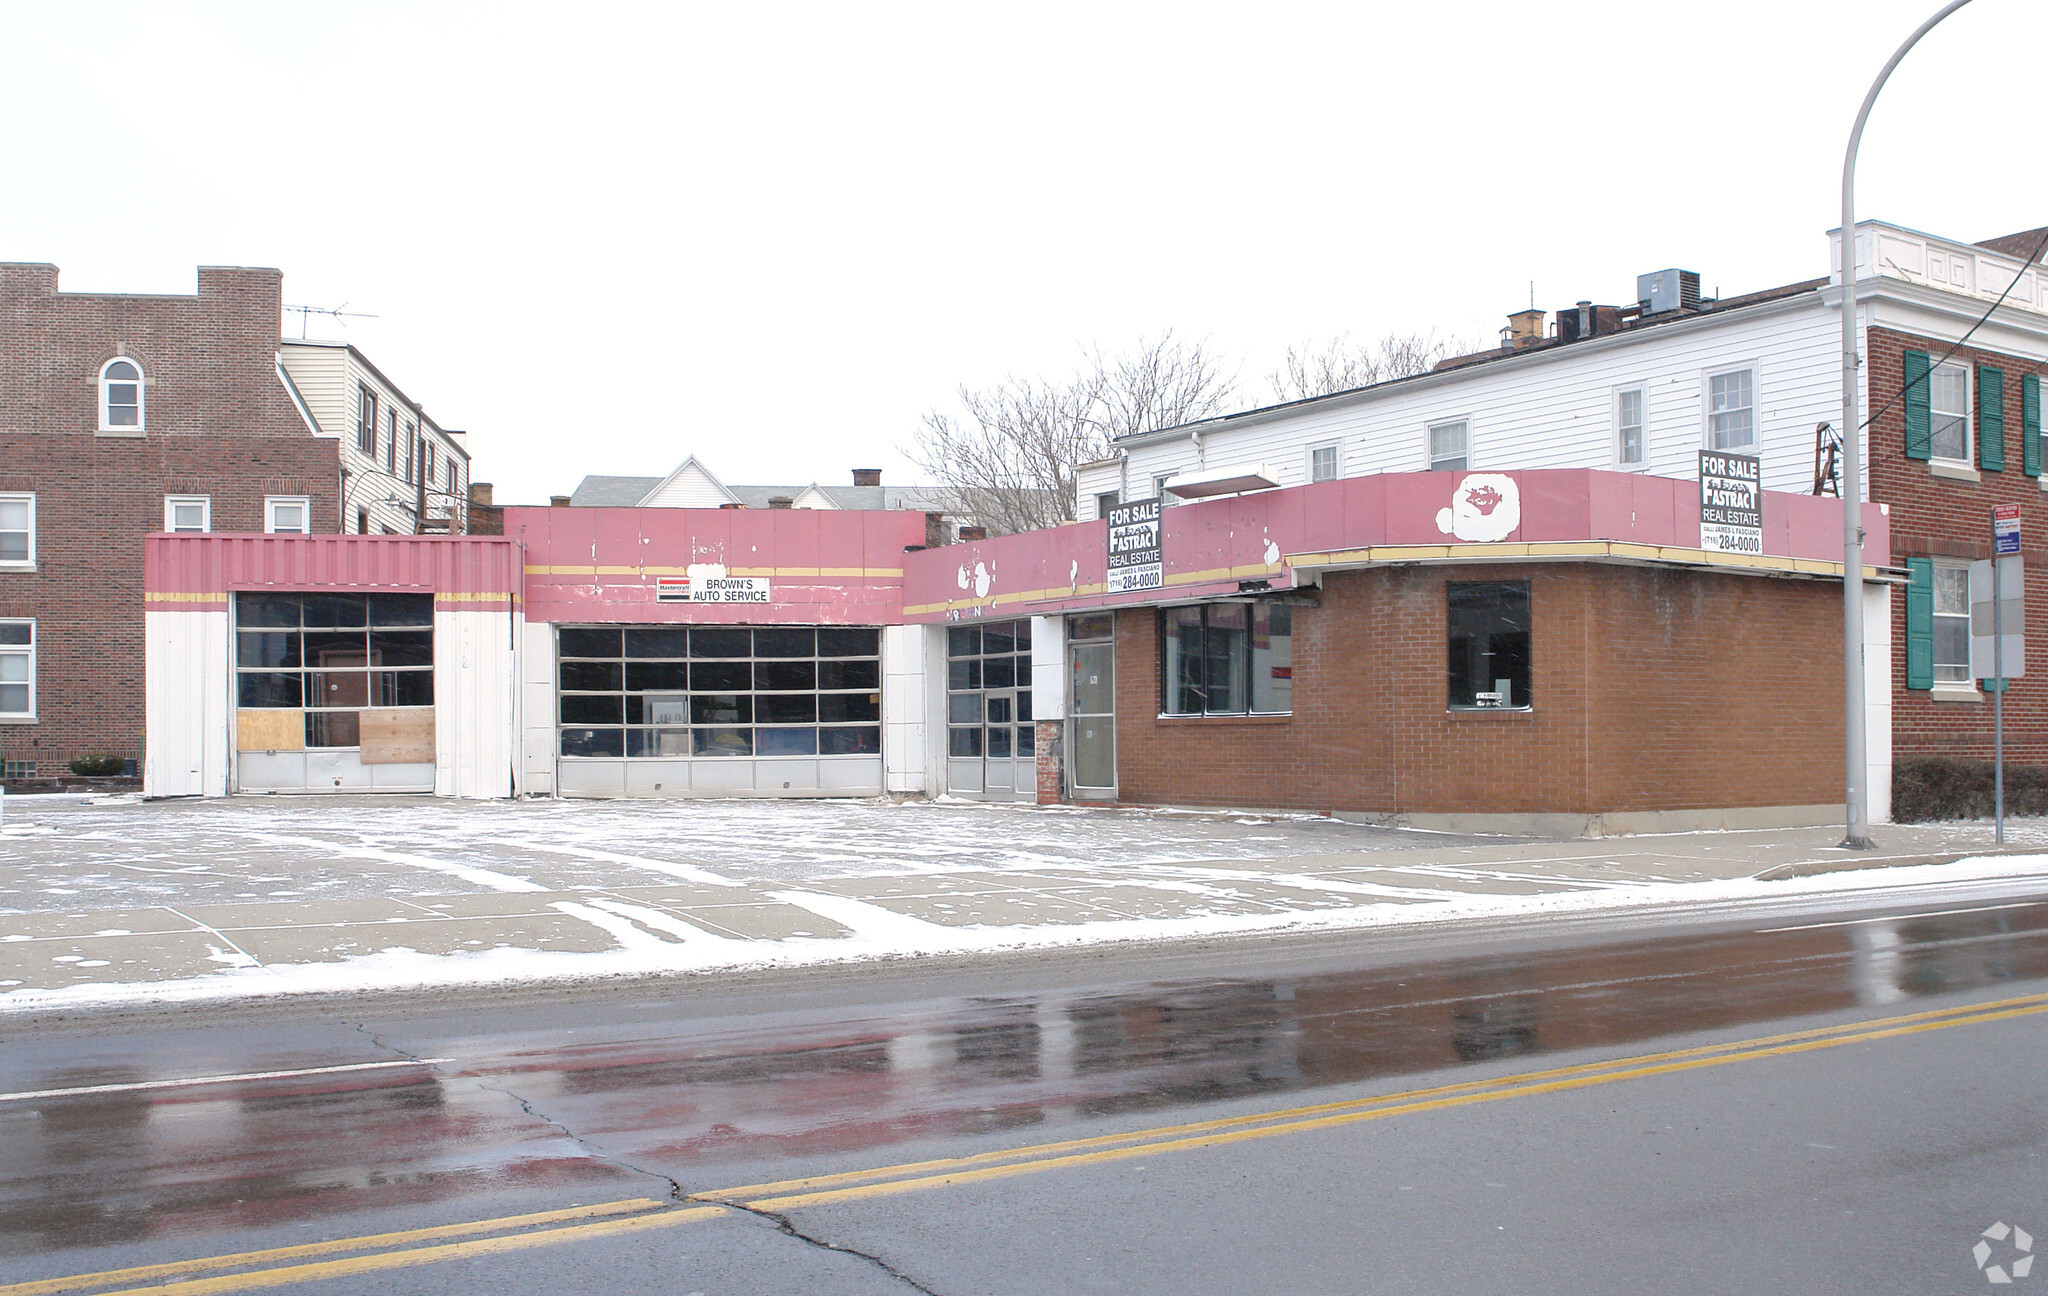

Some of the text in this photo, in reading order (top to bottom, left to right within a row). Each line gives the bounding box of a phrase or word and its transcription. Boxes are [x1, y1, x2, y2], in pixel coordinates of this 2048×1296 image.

[1702, 456, 1758, 479] FOR SALE
[1702, 475, 1758, 510] FASTRACT
[1109, 502, 1160, 526] FOR SALE
[1703, 508, 1760, 526] REAL ESTATE
[1109, 520, 1159, 553] FASTRACT
[1719, 534, 1760, 552] 284-0000
[1109, 549, 1160, 568] REAL ESTATE
[706, 579, 753, 590] BROWN'S
[1122, 572, 1160, 589] 284-0000
[693, 591, 767, 601] AUTO SERVICE
